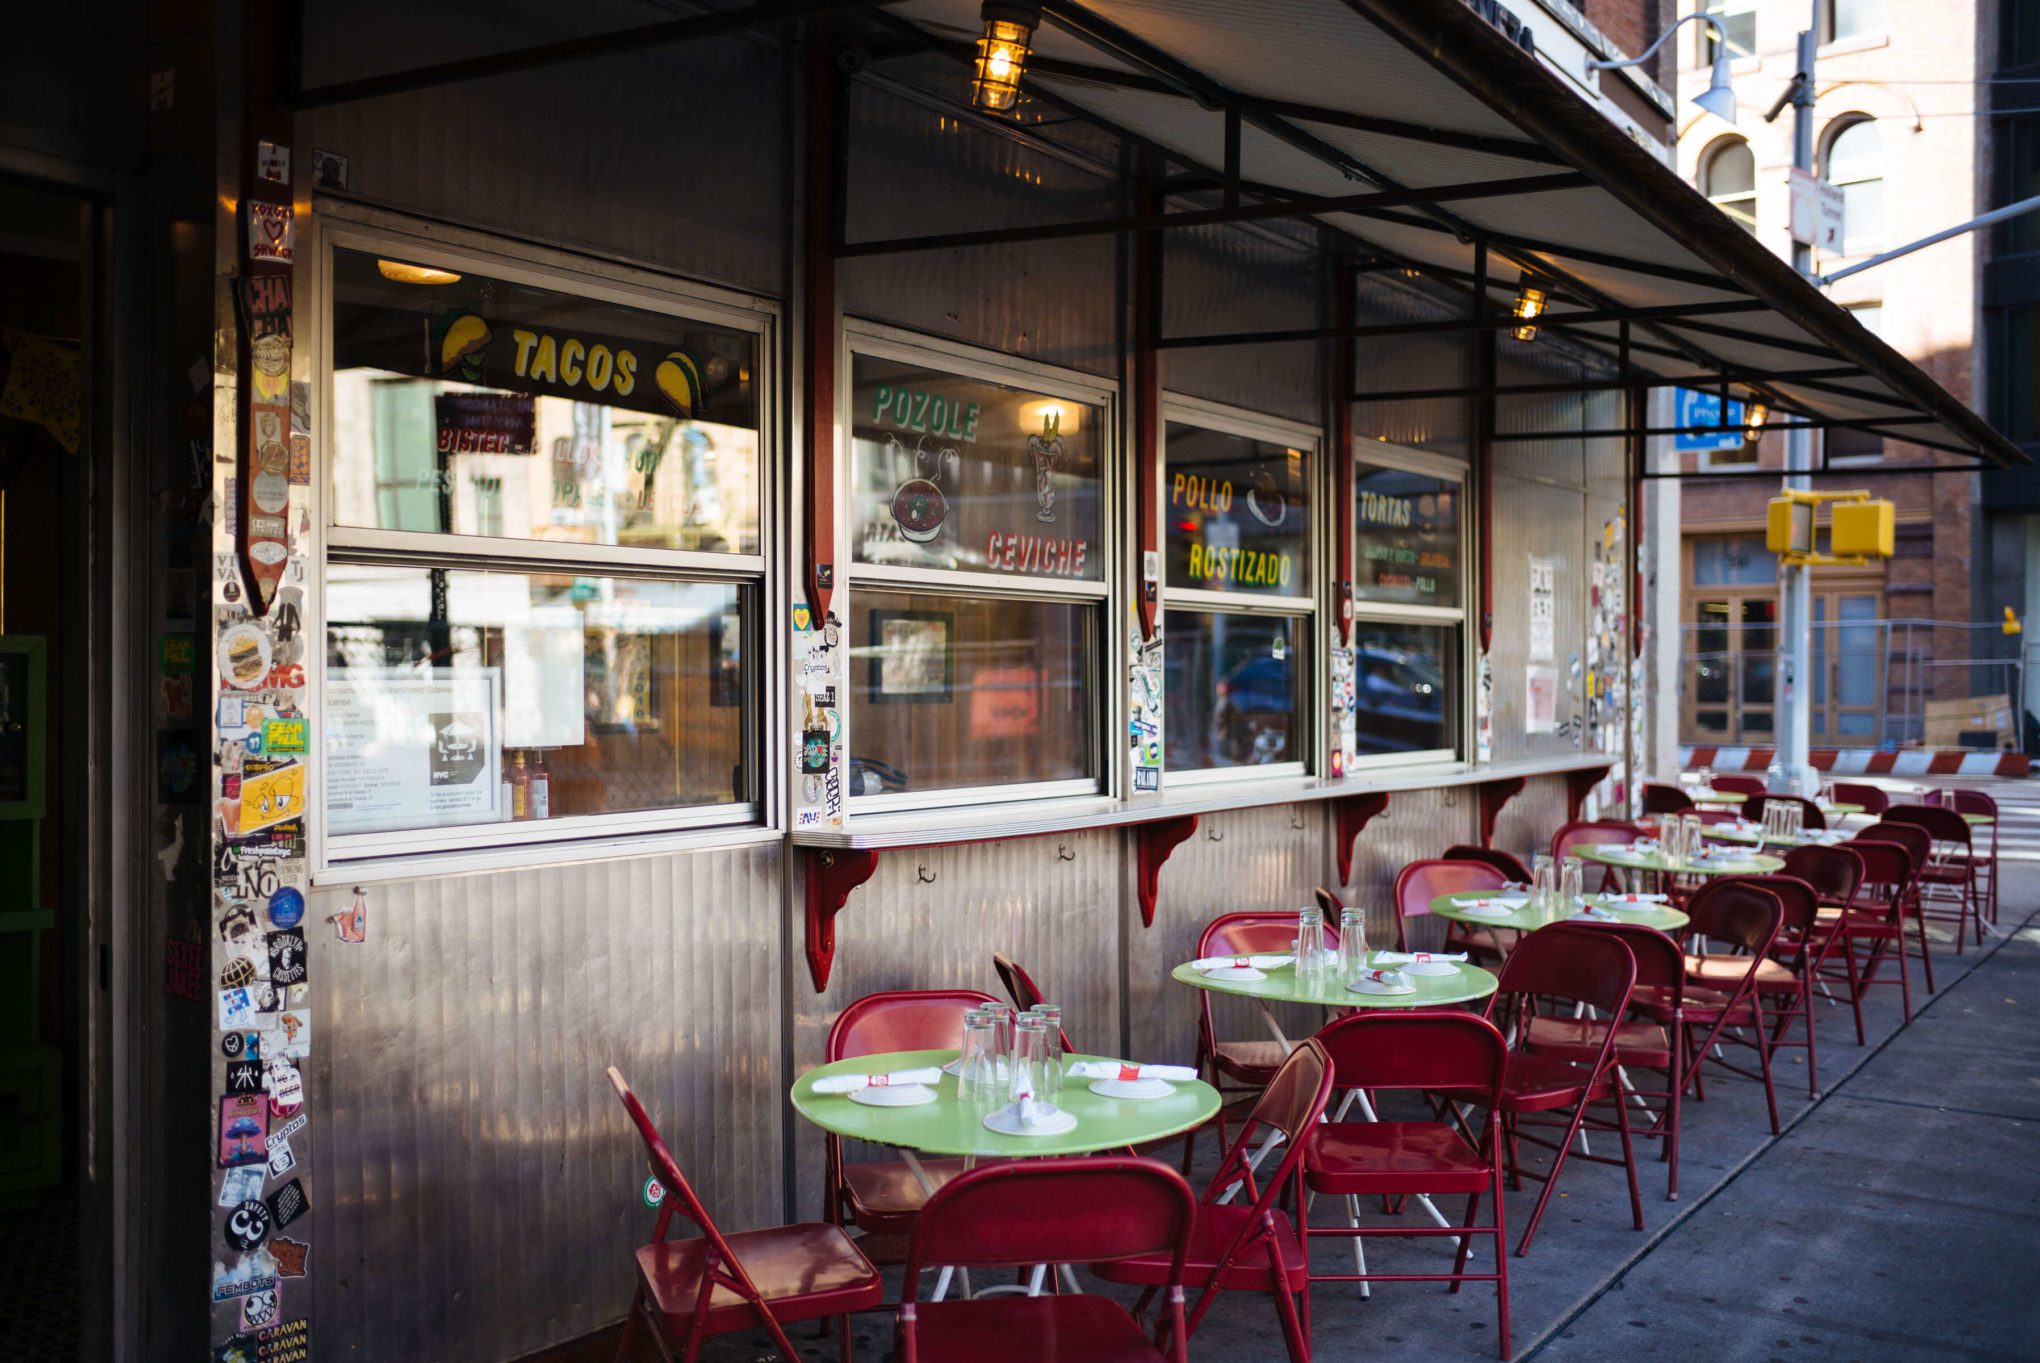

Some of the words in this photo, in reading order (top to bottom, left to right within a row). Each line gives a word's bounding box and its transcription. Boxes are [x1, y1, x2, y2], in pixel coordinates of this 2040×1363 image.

[513, 329, 638, 397] TACOS
[872, 383, 980, 444] POZOLE
[438, 427, 509, 455] BISTEC
[1172, 473, 1233, 514] POLLO
[1360, 491, 1412, 528] TORTAS
[985, 529, 1087, 576] CEVICHE
[1189, 543, 1292, 588] ROSTIZADO
[269, 721, 303, 732] SEAN
[269, 934, 304, 958] BROOKLYN
[272, 963, 304, 983] CASSETTES
[265, 1115, 306, 1149] Cryptos
[244, 1201, 269, 1221] SAFETY
[217, 1277, 274, 1297] FEMBOTS
[258, 1319, 307, 1341] CARAVAN
[258, 1334, 307, 1356] CARAVAN
